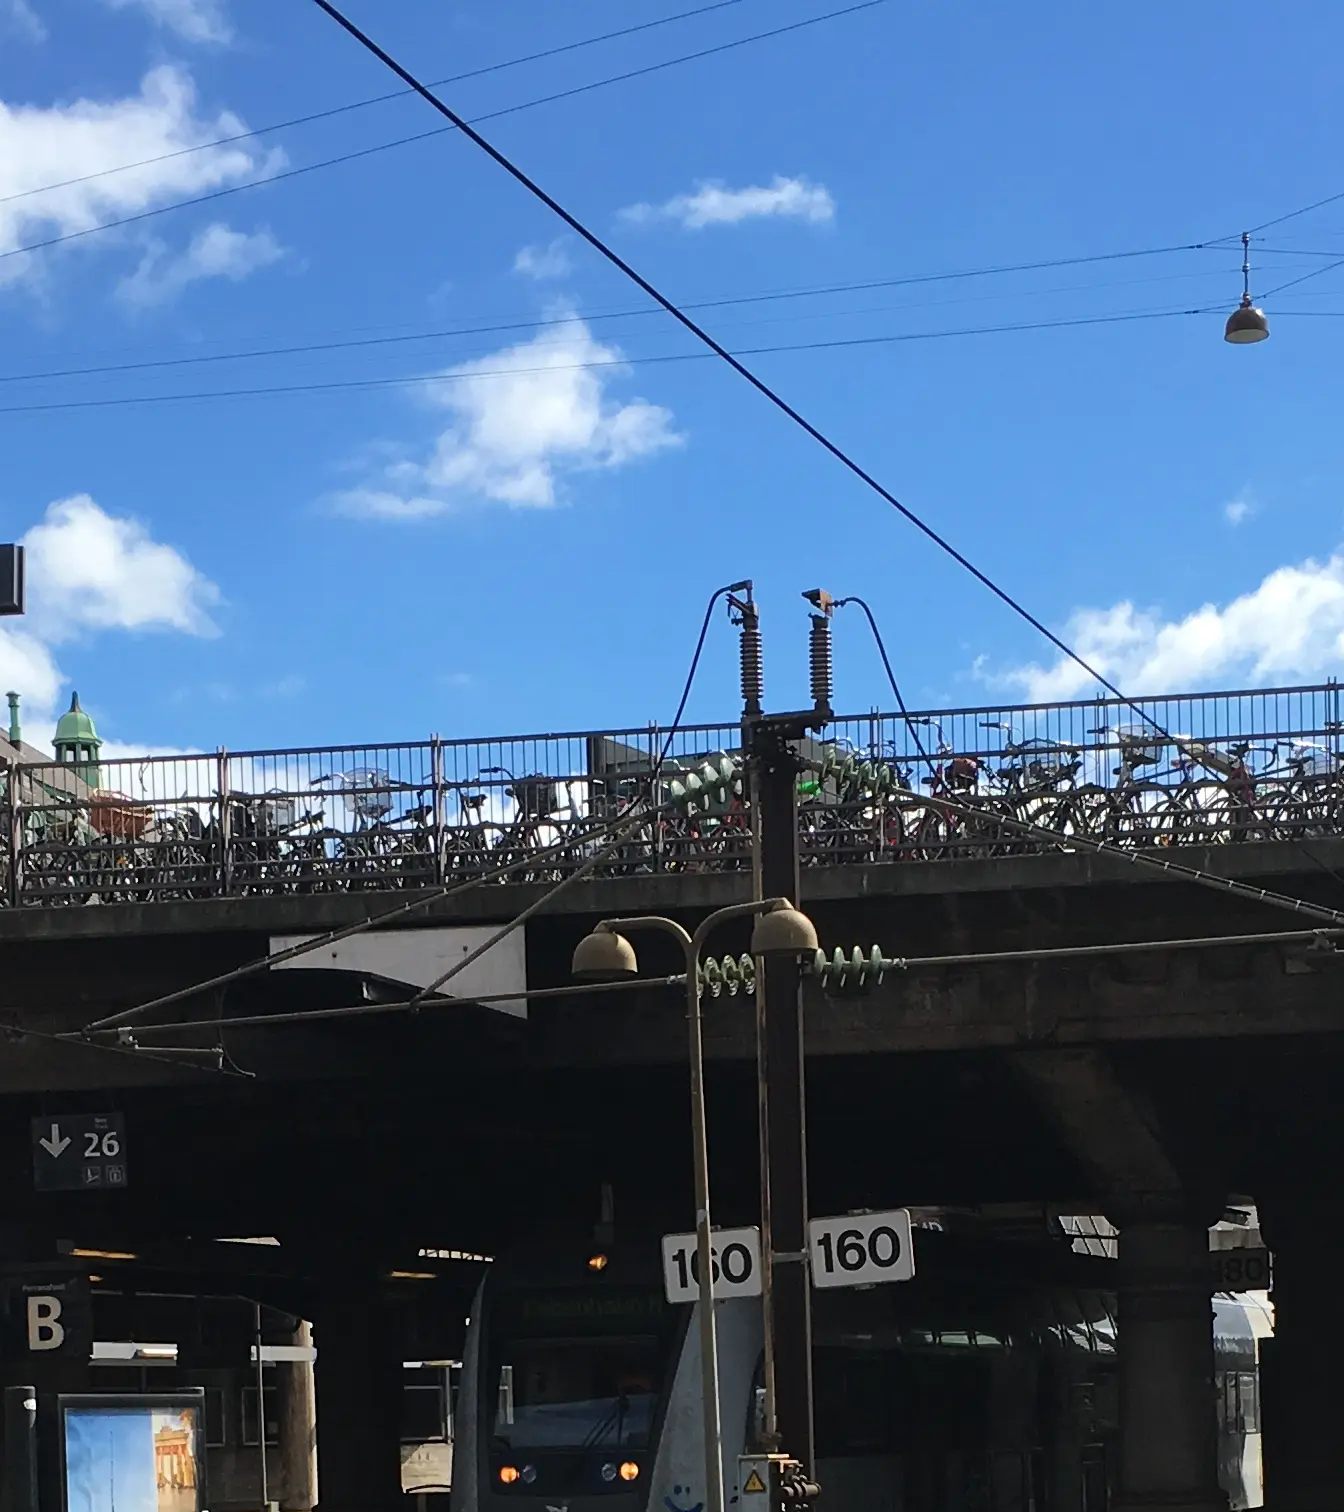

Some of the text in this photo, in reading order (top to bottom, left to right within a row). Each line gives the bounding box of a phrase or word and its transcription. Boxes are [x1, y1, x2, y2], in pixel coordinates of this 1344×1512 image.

[83, 1131, 120, 1158] 26
[672, 1242, 754, 1289] 160
[817, 1226, 901, 1273] 160
[26, 1295, 66, 1352] B
